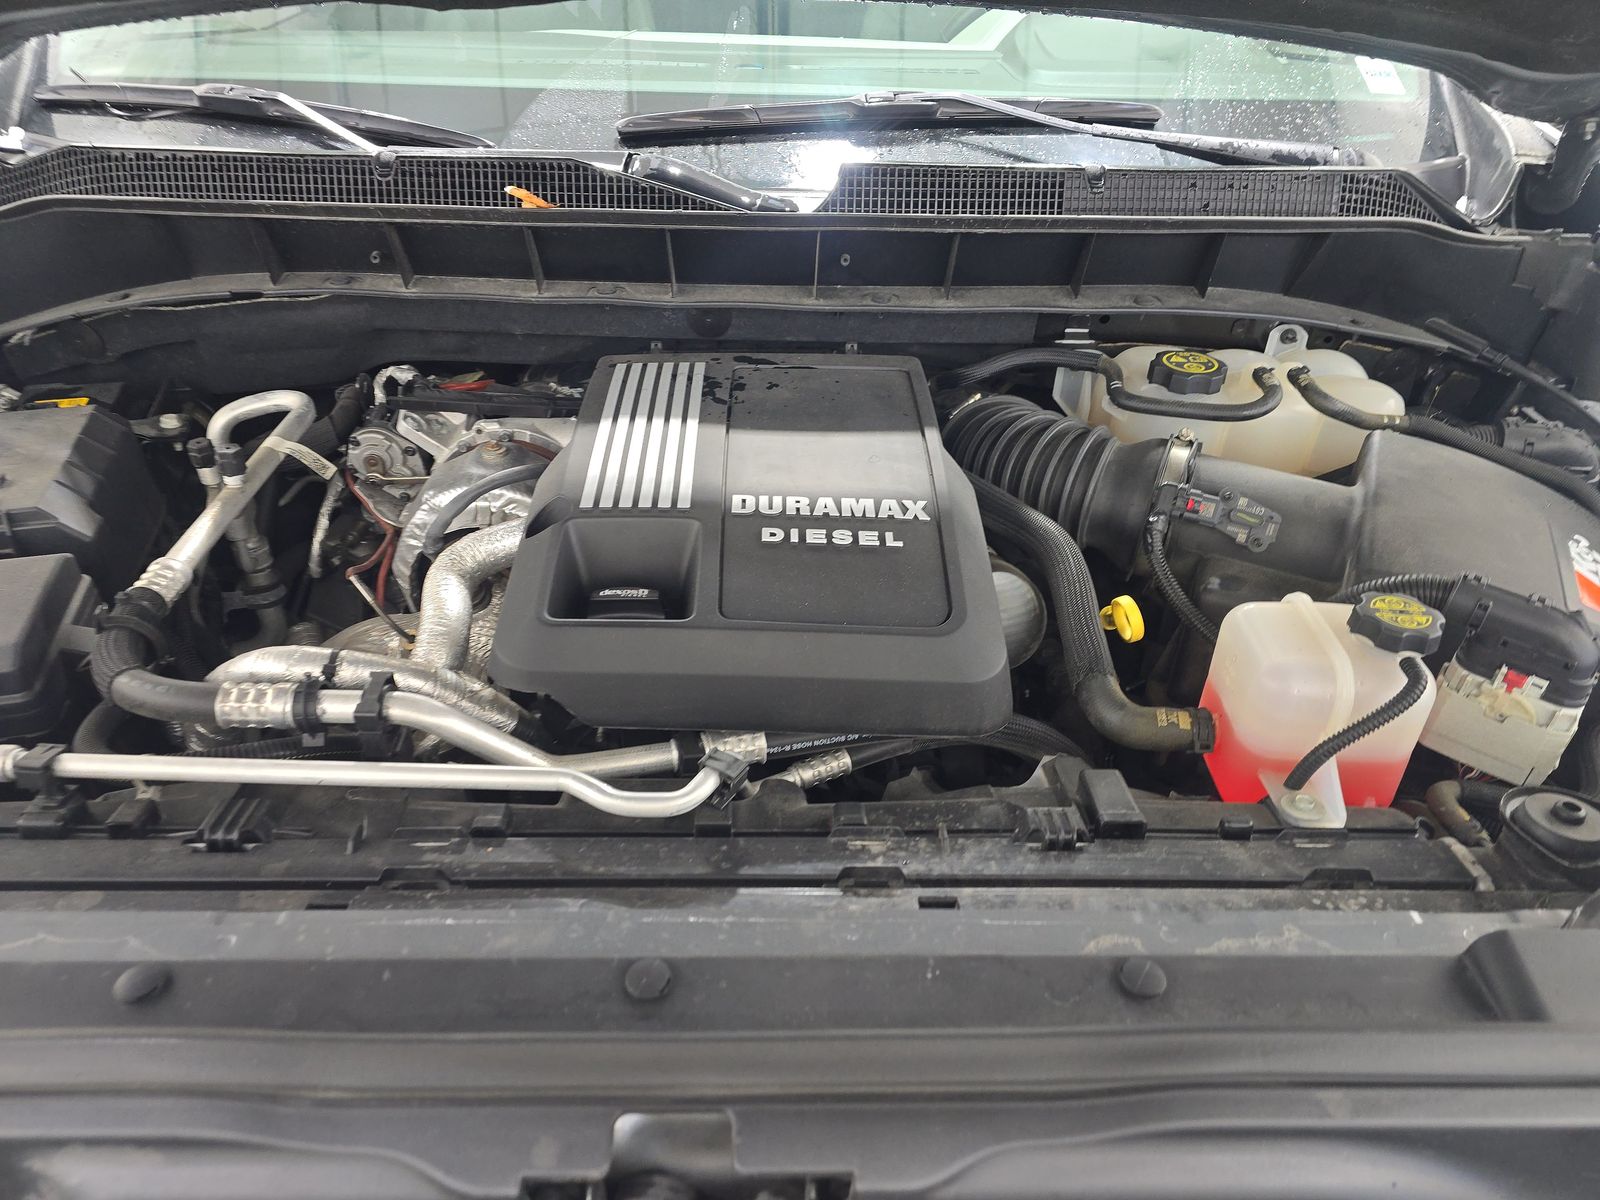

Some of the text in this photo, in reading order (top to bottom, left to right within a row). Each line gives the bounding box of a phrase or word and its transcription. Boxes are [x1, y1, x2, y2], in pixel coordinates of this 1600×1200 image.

[731, 494, 931, 520] DURAMAX
[761, 527, 904, 547] DIESEL
[792, 740, 812, 750] HOSE
[814, 735, 846, 746] SUCTION
